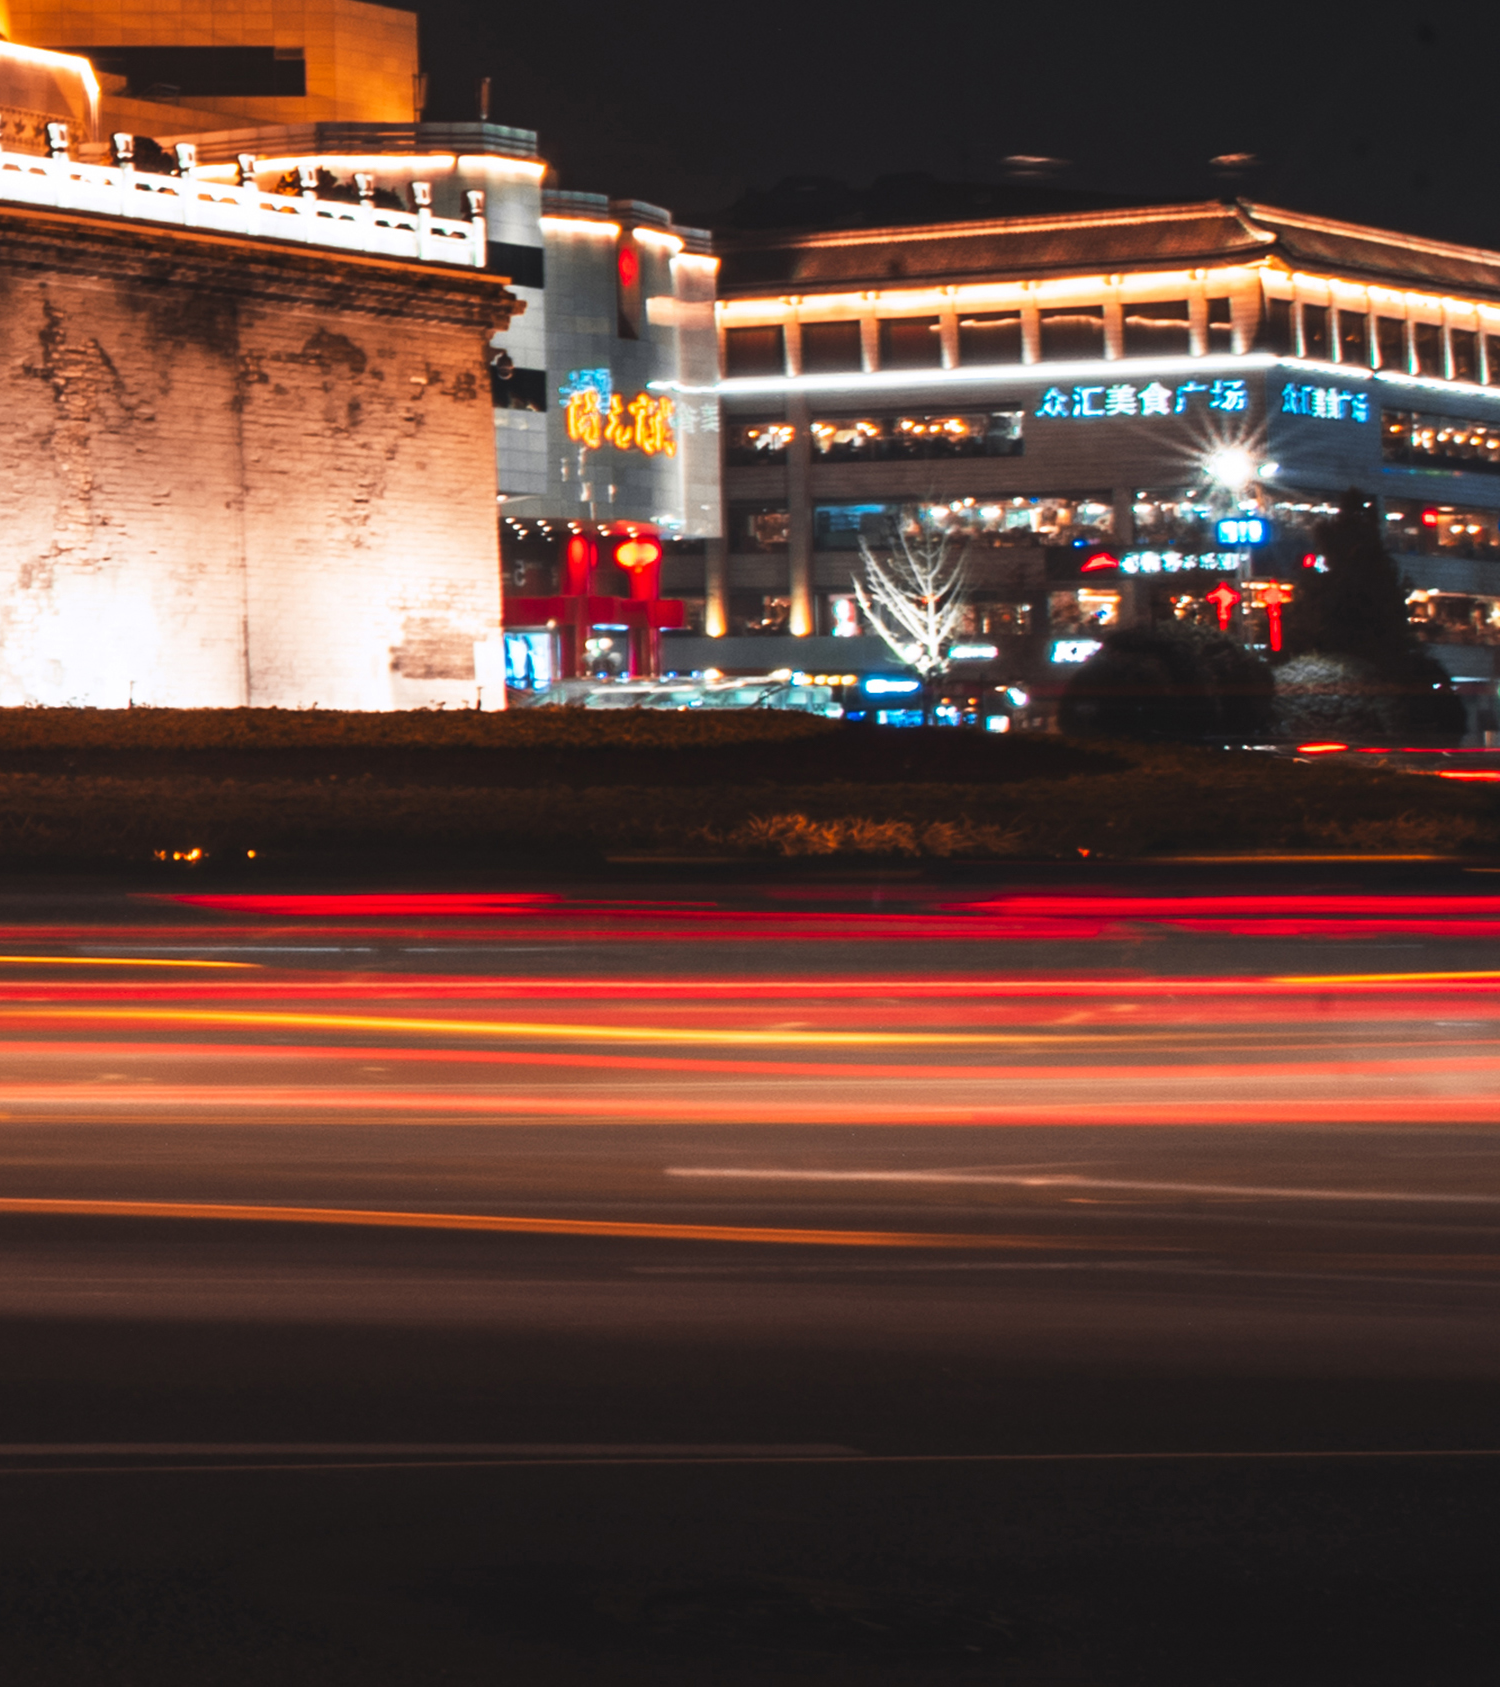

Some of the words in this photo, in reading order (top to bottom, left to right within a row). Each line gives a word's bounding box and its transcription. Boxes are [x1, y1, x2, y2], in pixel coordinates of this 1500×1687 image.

[1034, 379, 1248, 418] 众汇美食广场
